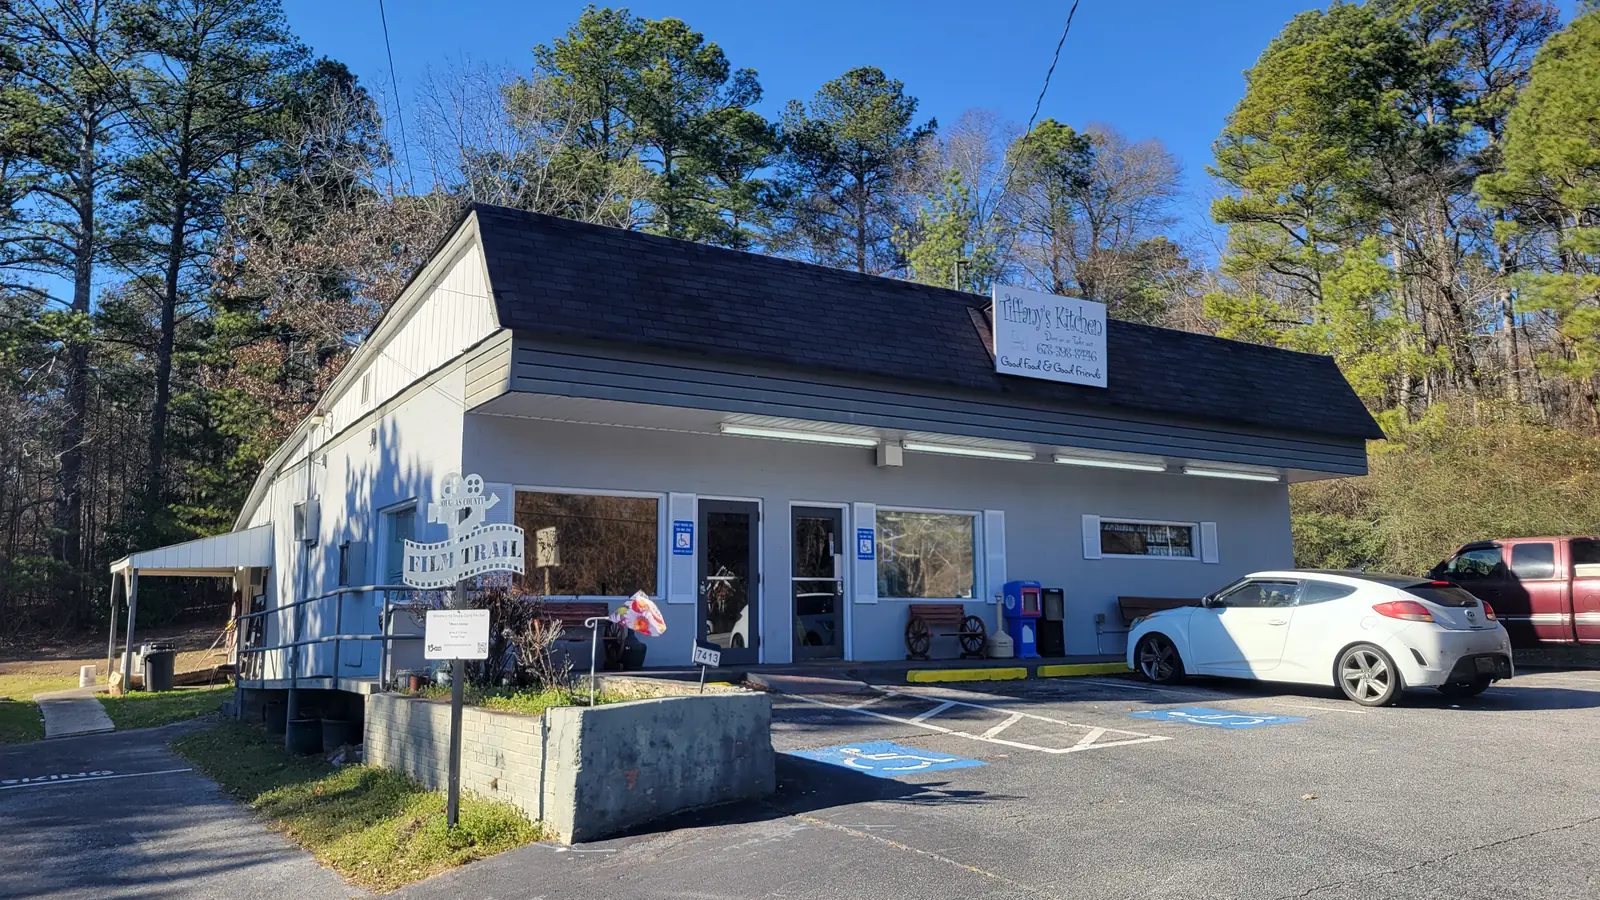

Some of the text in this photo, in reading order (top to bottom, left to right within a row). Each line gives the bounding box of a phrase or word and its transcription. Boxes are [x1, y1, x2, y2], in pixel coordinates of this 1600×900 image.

[999, 293, 1103, 336] Tiffany's Kitchen
[1000, 356, 1101, 380] Good Food & Good Friends
[463, 496, 484, 506] COUNTY
[408, 540, 522, 573] FILM TRAIL
[697, 649, 719, 663] 7413
